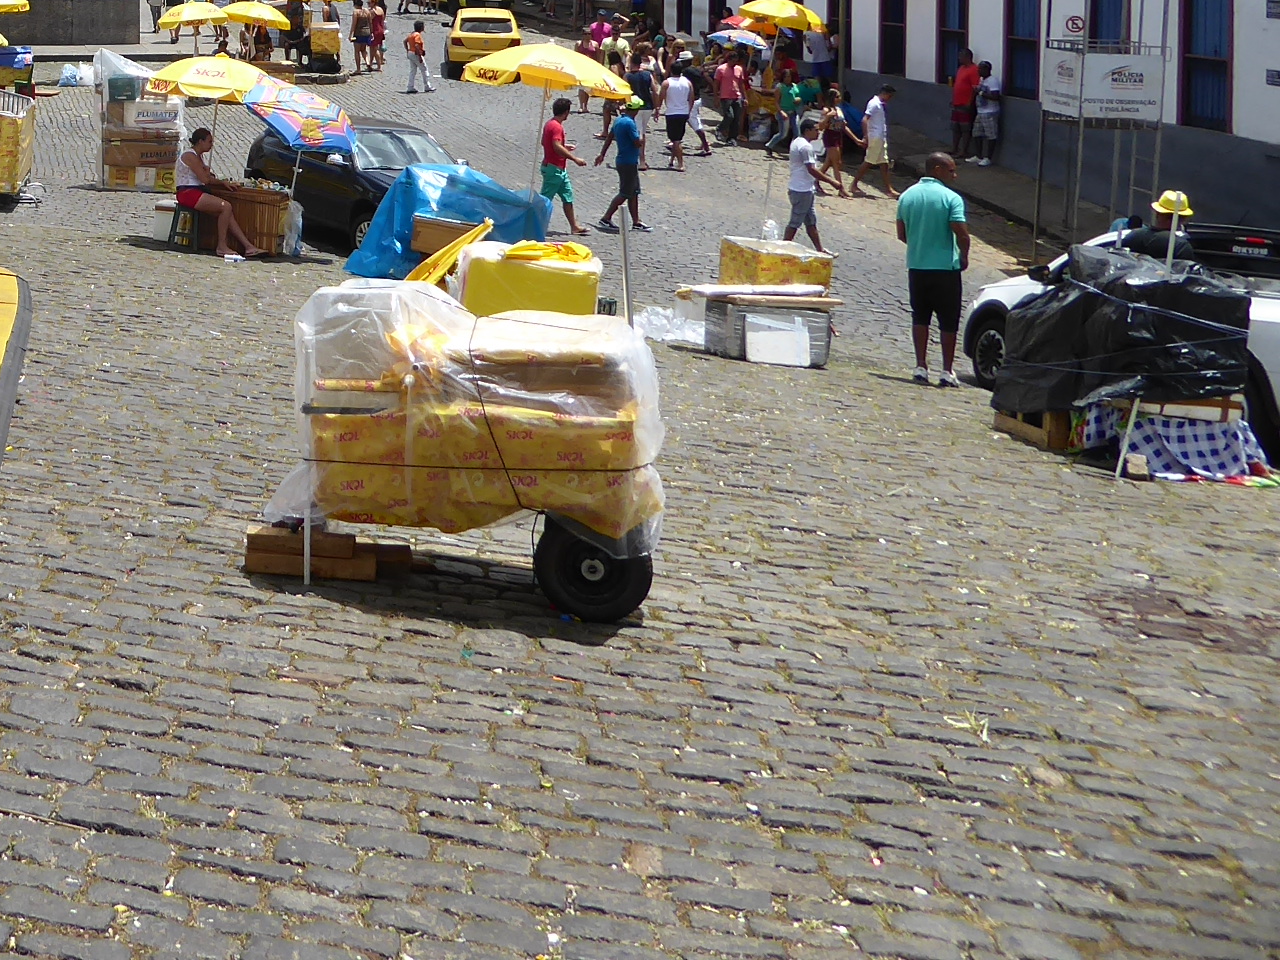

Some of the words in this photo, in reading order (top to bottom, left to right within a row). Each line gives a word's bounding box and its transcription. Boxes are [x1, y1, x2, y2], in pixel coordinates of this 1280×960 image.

[193, 67, 227, 79] SKOL
[476, 68, 499, 80] SKOL
[136, 110, 179, 119] PLUMATEX
[506, 430, 534, 440] SKOL
[463, 450, 490, 461] SKOL
[556, 451, 584, 462] SKOL
[340, 480, 365, 490] SKOL
[512, 476, 539, 487] SKOL
